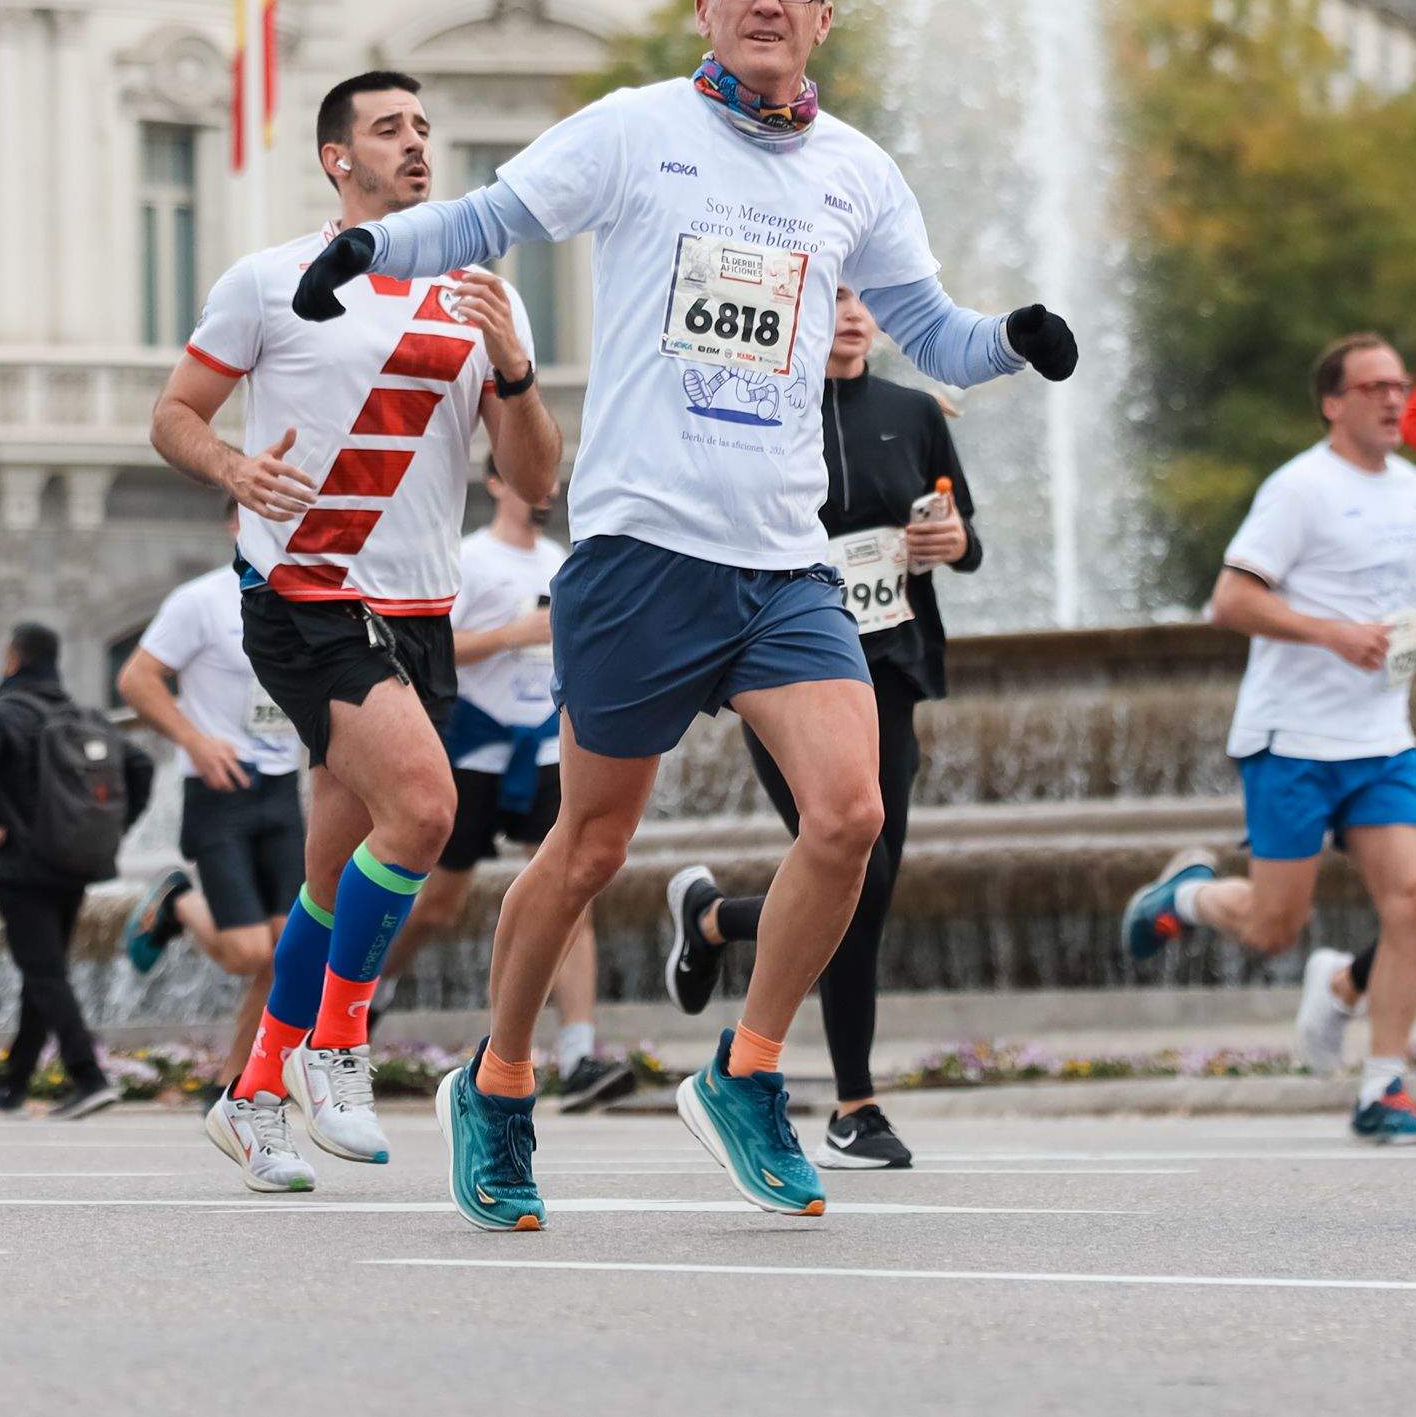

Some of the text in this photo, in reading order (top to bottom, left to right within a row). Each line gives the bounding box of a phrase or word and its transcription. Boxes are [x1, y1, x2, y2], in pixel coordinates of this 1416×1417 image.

[660, 161, 698, 177] HOKA
[824, 194, 853, 214] MARCA
[706, 197, 814, 233] Soy Merengue
[690, 219, 733, 237] corro
[720, 264, 763, 277] AFICIONES
[721, 256, 731, 265] EL
[732, 258, 756, 268] DERBI
[685, 297, 780, 347] 6818
[706, 435, 716, 445] de
[718, 437, 730, 447] las
